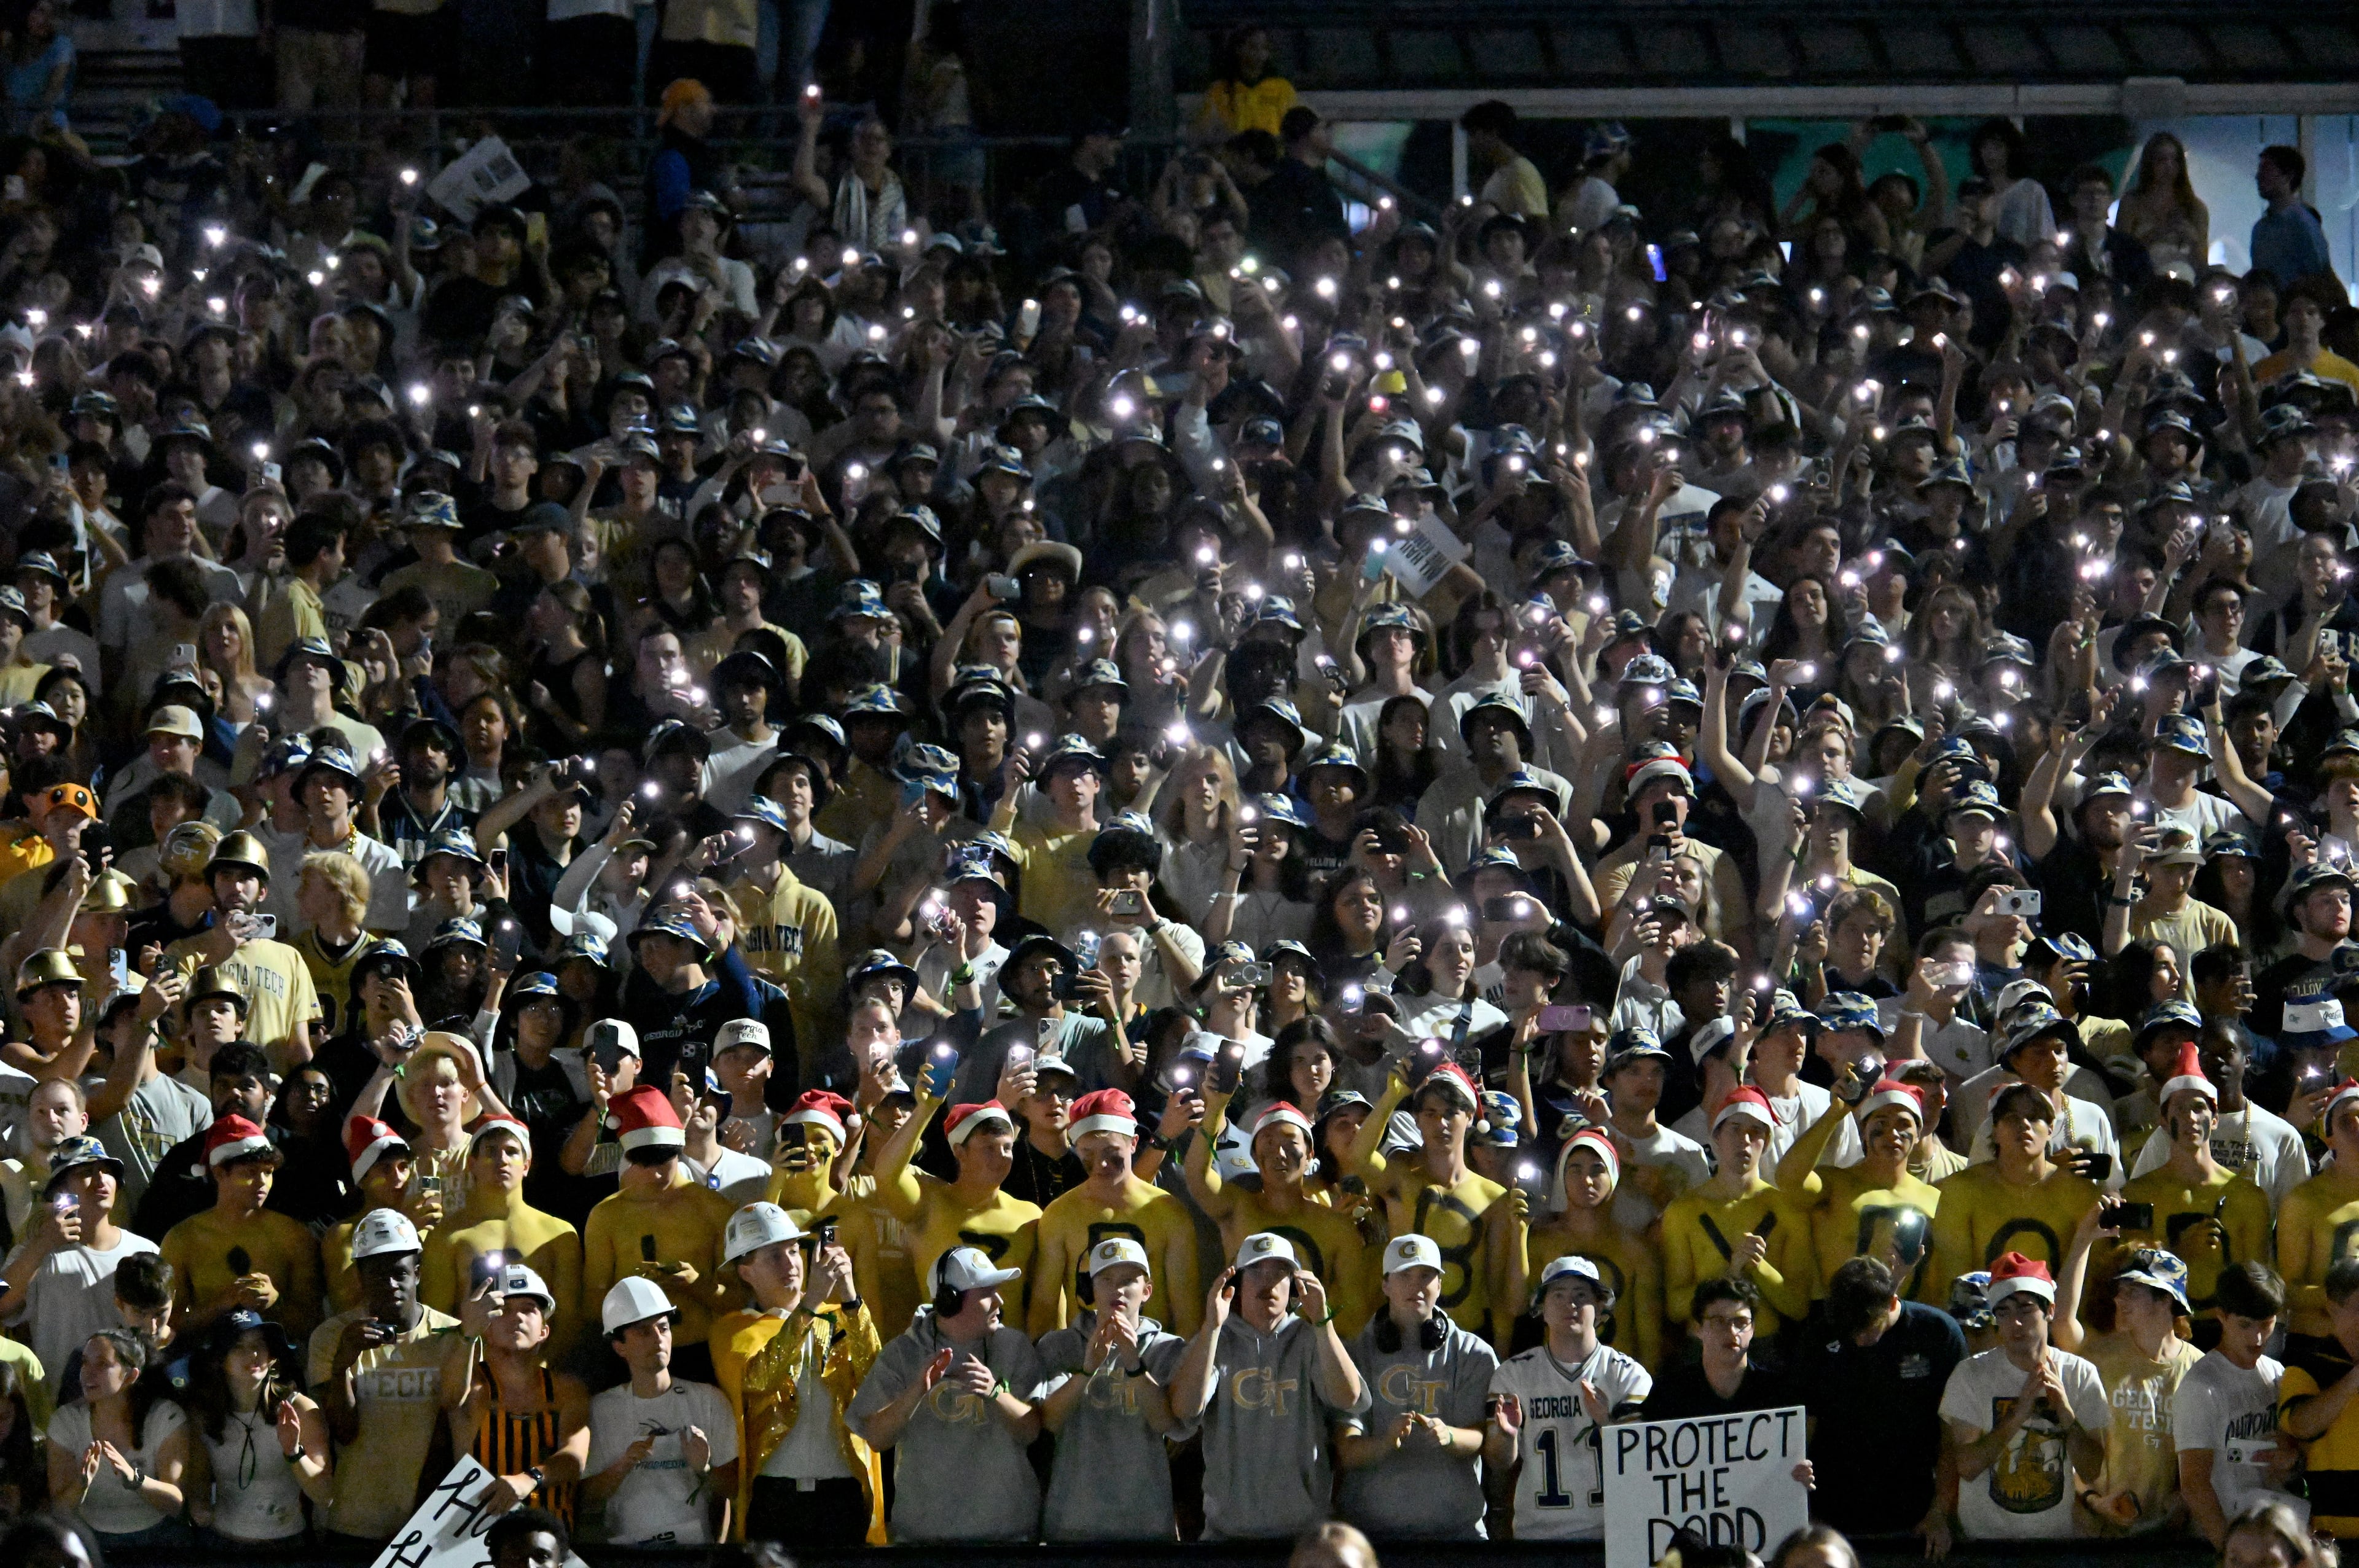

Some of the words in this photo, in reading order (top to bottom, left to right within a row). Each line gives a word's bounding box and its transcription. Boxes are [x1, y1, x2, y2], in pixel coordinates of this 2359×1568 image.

[173, 840, 200, 860] GT
[256, 965, 284, 999] TECH
[1232, 1367, 1298, 1418] GT
[1379, 1363, 1449, 1416] GT
[1616, 1410, 1798, 1476] PROTECT
[1653, 1468, 1732, 1517] THE
